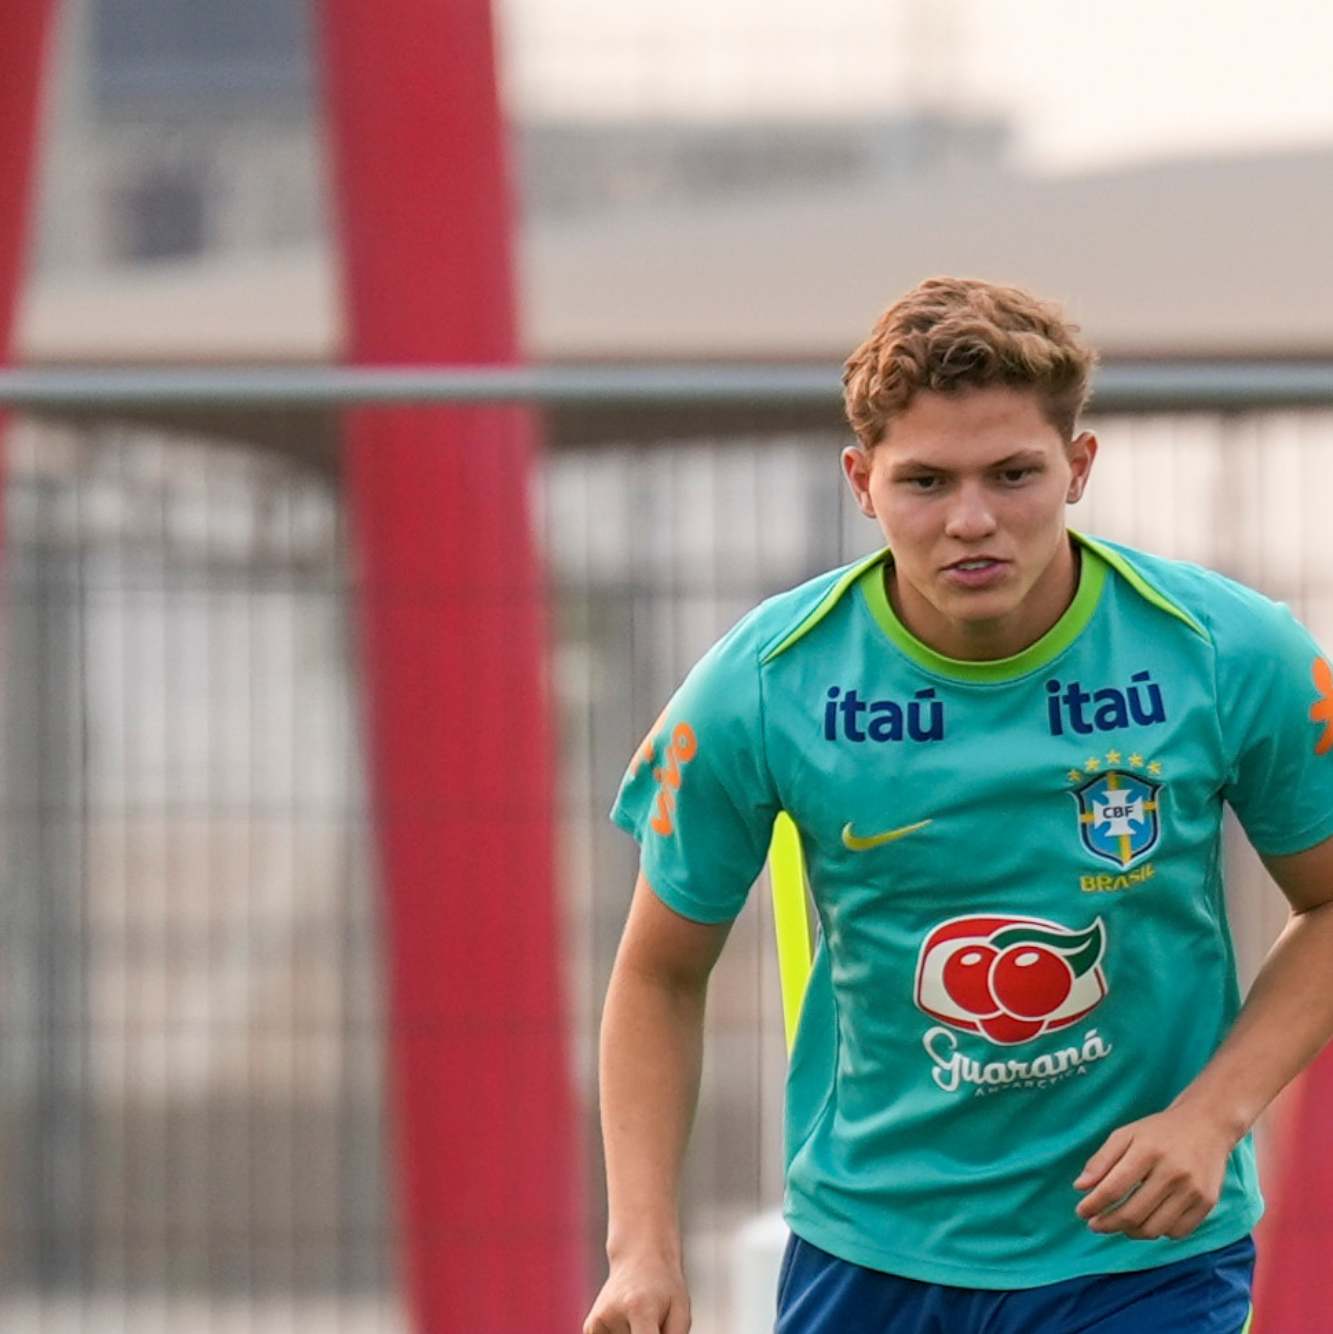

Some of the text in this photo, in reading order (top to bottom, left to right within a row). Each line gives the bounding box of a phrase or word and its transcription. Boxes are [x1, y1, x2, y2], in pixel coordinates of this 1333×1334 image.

[824, 686, 944, 742] itaú
[1045, 669, 1166, 736] itaú
[1102, 804, 1135, 819] CBF
[922, 1026, 1112, 1092] Guaraná
